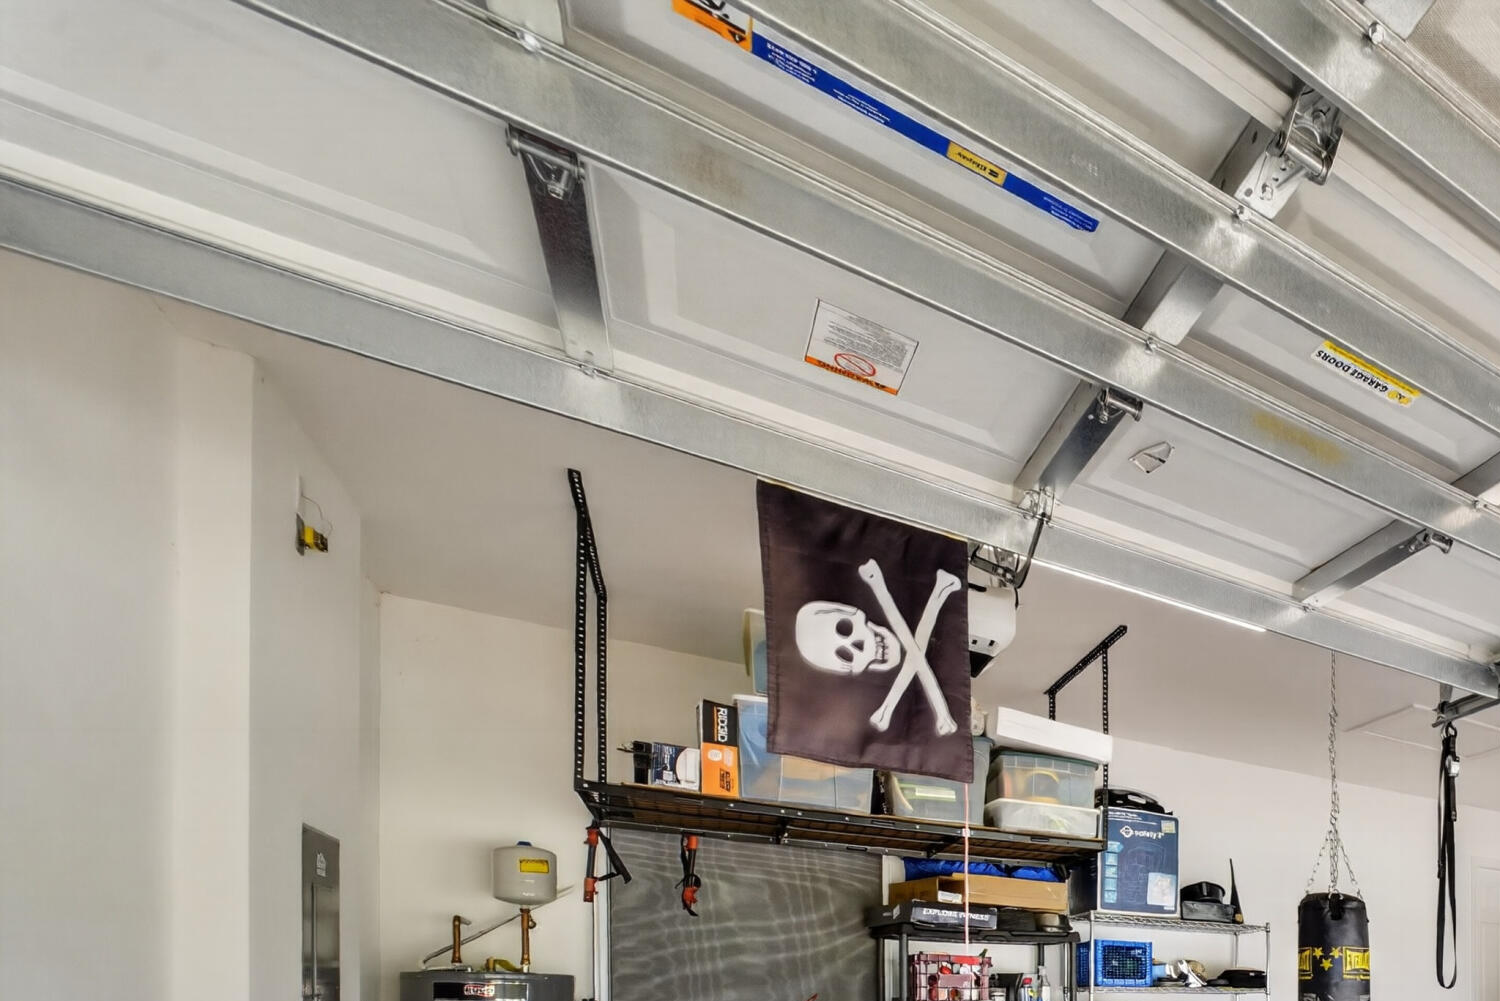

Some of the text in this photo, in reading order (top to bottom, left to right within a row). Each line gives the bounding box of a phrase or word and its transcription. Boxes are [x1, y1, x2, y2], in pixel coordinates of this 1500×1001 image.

[1315, 350, 1389, 393] GARAGE DOORS
[717, 706, 729, 743] RIDGID
[959, 911, 990, 921] FINESS
